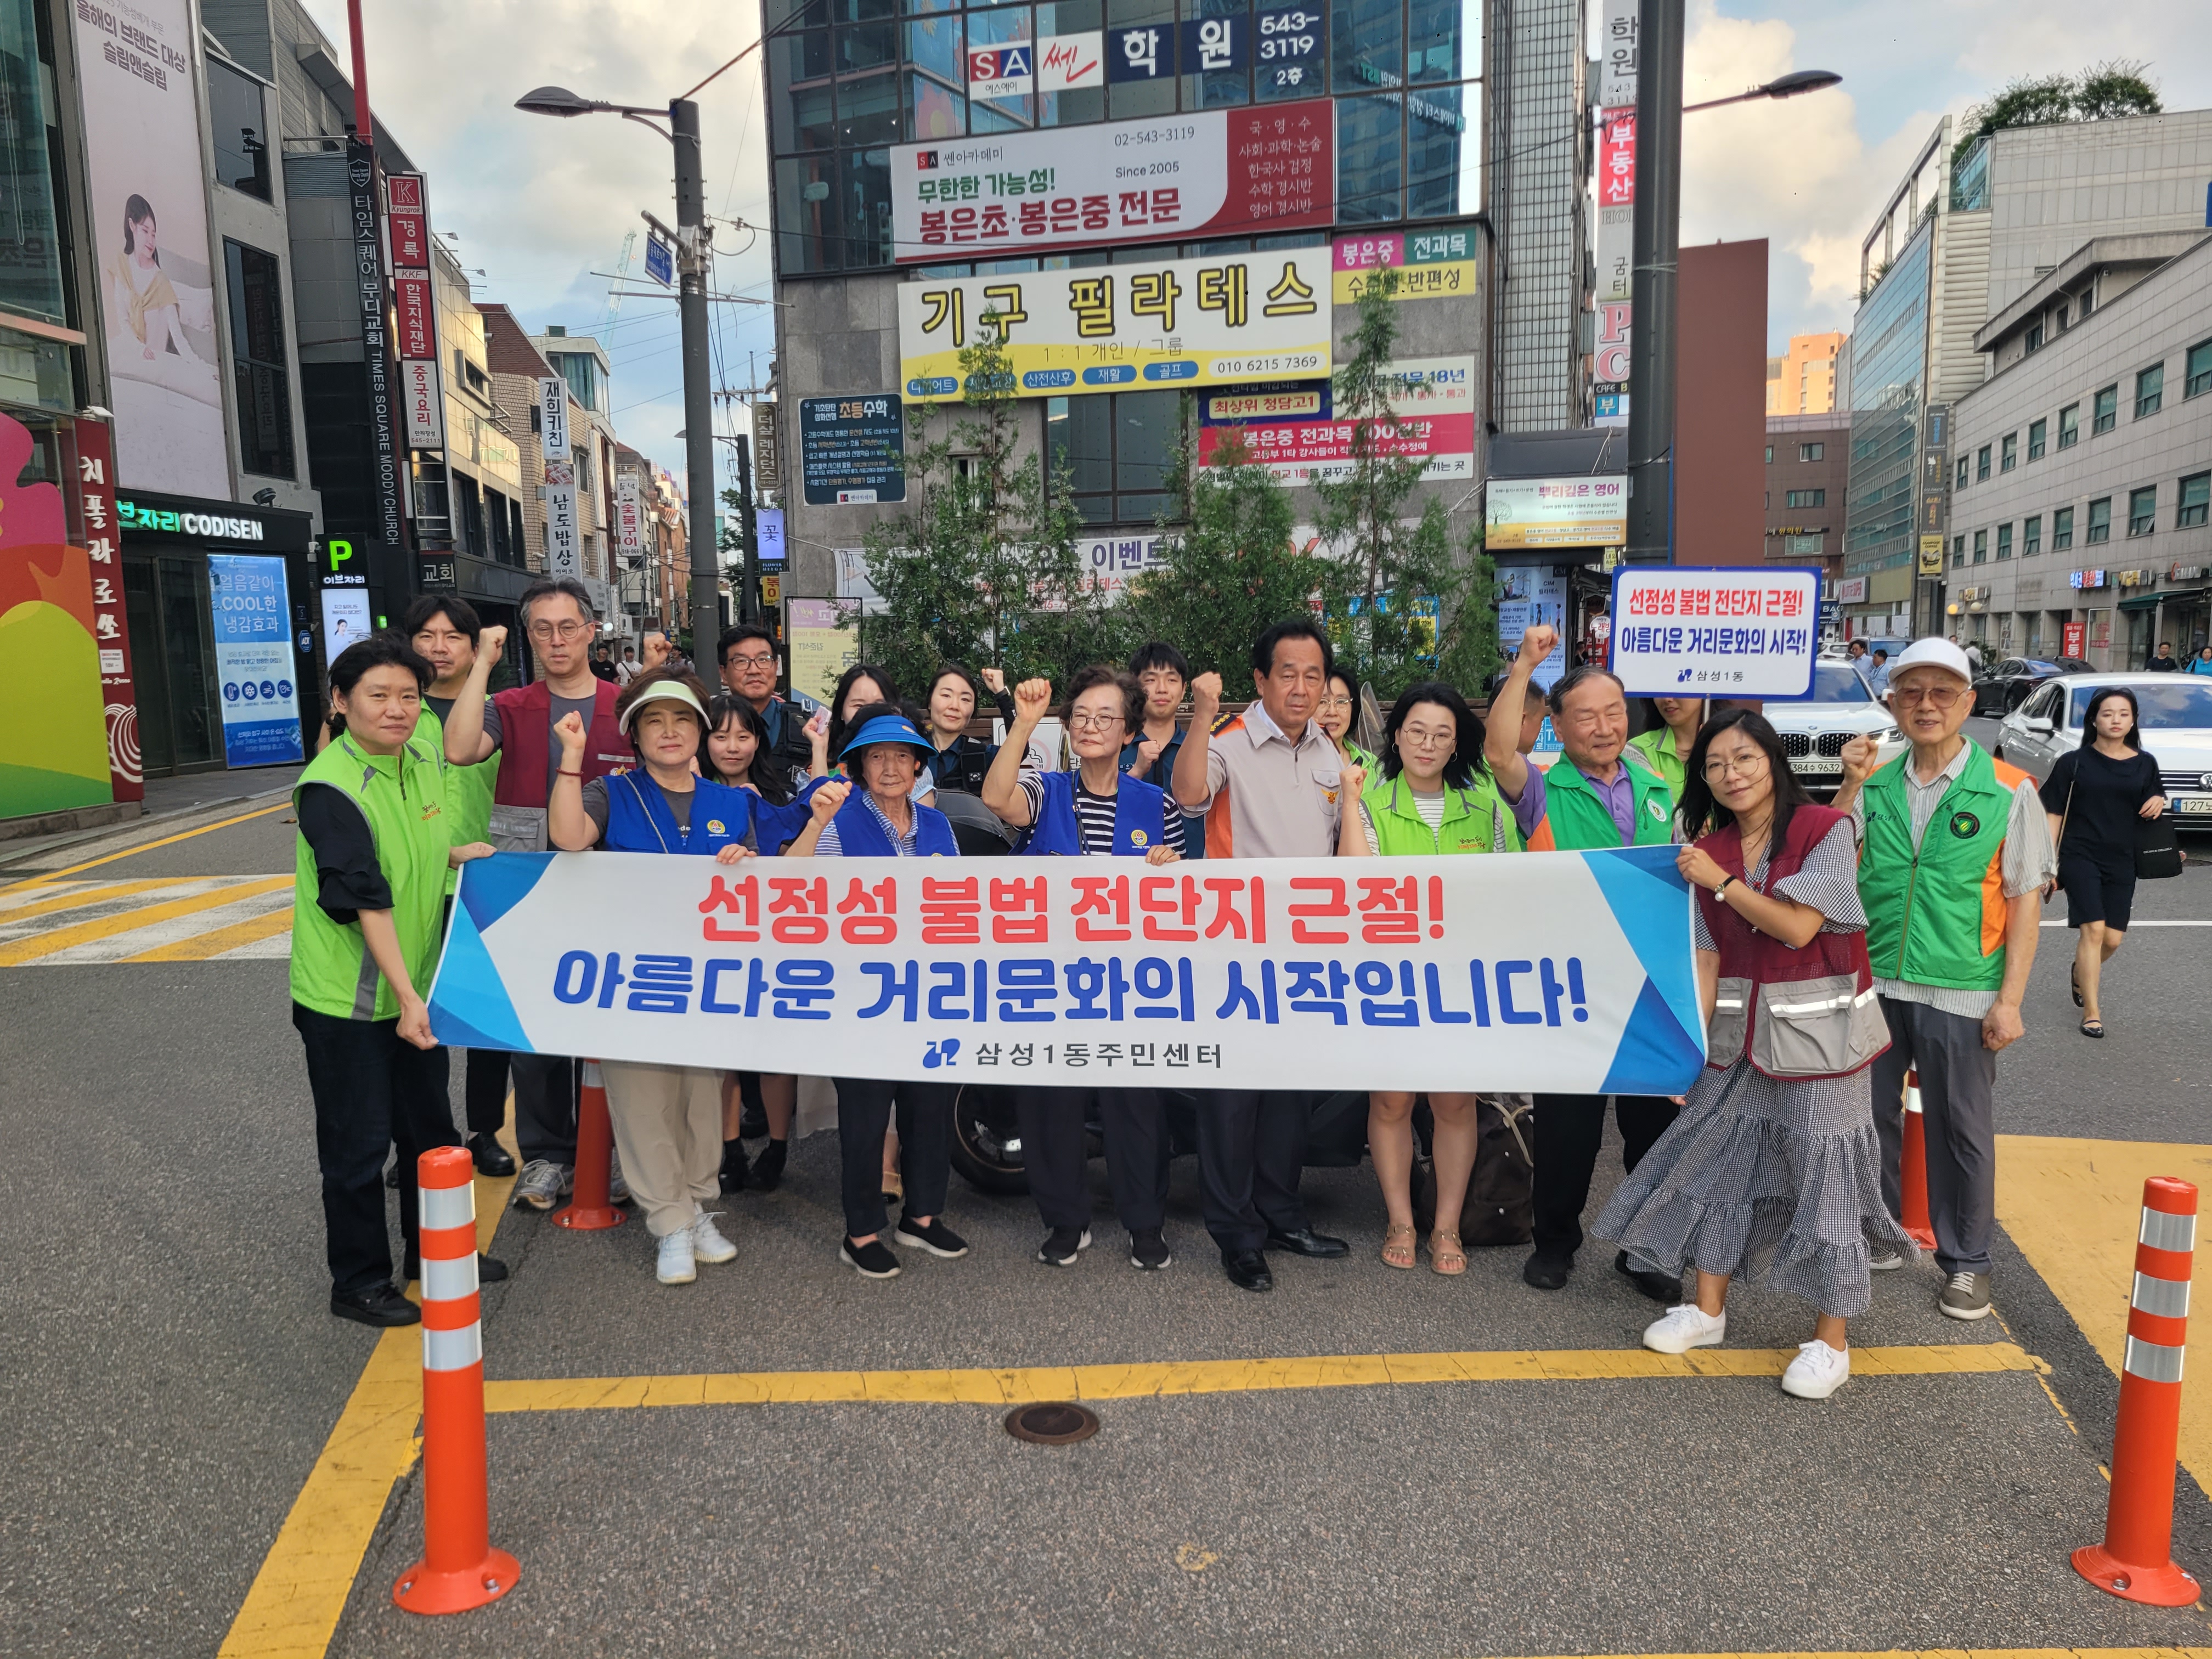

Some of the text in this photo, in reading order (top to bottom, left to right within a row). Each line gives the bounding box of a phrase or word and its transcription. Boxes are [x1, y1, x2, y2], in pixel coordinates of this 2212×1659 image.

[1261, 12, 1319, 35] 543-
[77, 0, 187, 74] 올해의 브랜드 대상
[1261, 36, 1313, 59] 3119
[103, 41, 167, 92] 슬립앤슬립
[1043, 42, 1098, 83] 쎈
[1277, 67, 1302, 86] 2층
[985, 82, 1017, 95] 에스에이
[1114, 127, 1194, 146] 02-543-3119
[944, 146, 1003, 166] 쎈아카데미
[1249, 157, 1311, 178] 한국사 검정
[1607, 124, 1634, 203] 부동산
[1115, 162, 1180, 178] Since 2005
[396, 181, 415, 204] K
[918, 167, 1056, 204] 무한한 가능성!
[1249, 177, 1312, 199] 수학 경시반
[1119, 188, 1181, 227] 전문
[1250, 198, 1312, 218] 영어 경시반
[397, 220, 420, 259] 경록
[1342, 233, 1466, 266] 봉은중 전과목
[354, 195, 383, 347] 타임스퀘어 무디교회
[401, 270, 422, 279] KKF
[1408, 268, 1460, 293] 반편성
[921, 261, 1317, 348] 기구 필라테스
[405, 283, 426, 354] 한국지식재단
[1092, 341, 1124, 363] 개인
[1149, 337, 1183, 357] 그룹
[1098, 367, 1120, 382] 재활
[1159, 364, 1182, 379] 골프
[1217, 356, 1317, 373] 010 6215 7369
[1429, 369, 1465, 383] 18년
[1028, 371, 1071, 388] 산전산후
[1596, 385, 1616, 393] CAFE
[413, 365, 431, 426] 중국요리
[1215, 396, 1314, 414] 최상위 청담고1
[839, 399, 888, 419] 초등수학
[1243, 428, 1294, 448] 봉은중
[1300, 425, 1353, 445] 전과목
[371, 351, 399, 546] TIMES SQUARE MOODY CHURCH
[1282, 449, 1296, 458] 1타
[1299, 447, 1336, 457] 강사들이
[1454, 461, 1465, 471] 곳
[1538, 483, 1620, 498] 뿌리깊은 영어
[180, 513, 263, 540] CODISEN
[553, 493, 573, 566] 남도밥상
[621, 504, 637, 547] 숯불구이
[763, 525, 779, 542] 꽃
[330, 540, 353, 571] P
[220, 574, 274, 592] 얼음같이
[323, 574, 365, 584] 이브자리
[423, 563, 455, 583] 교회
[221, 595, 277, 612] COOL한
[1629, 588, 1803, 617] 선정성 불법 전단지 근절!
[224, 616, 279, 634] 냉감효과
[1621, 627, 1683, 654] 아름다운
[1687, 627, 1766, 655] 거리문화의
[1769, 628, 1807, 656] 시작!
[2068, 631, 2080, 658] 부동
[1697, 670, 1744, 682] 삼성1동
[1818, 763, 1840, 772] 9632
[698, 874, 1445, 944] 선정성 불법 전단지 근절!
[552, 949, 1589, 1028] 아름다운 거리문화의 시작입니다!
[974, 1040, 1222, 1069] 삼성1동주민센터
